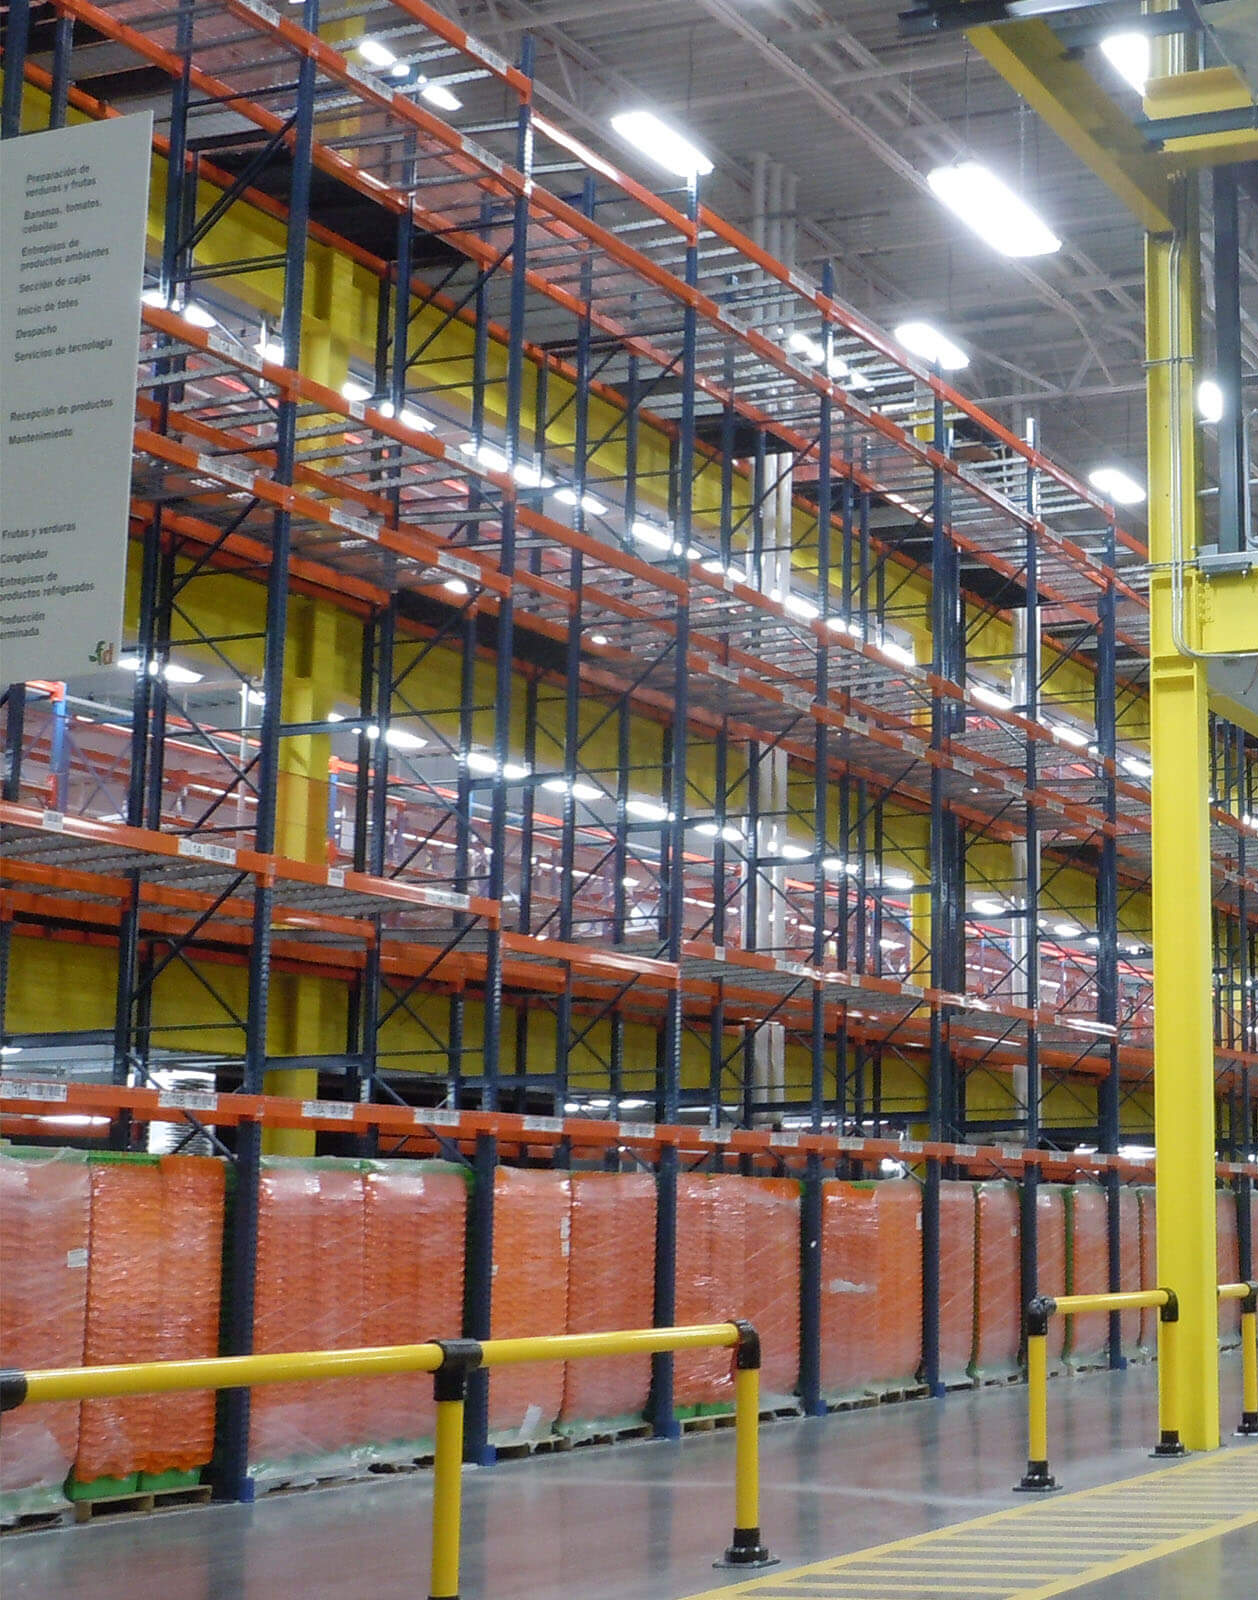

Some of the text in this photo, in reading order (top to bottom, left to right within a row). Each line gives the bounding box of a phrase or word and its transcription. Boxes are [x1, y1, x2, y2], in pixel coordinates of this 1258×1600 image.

[26, 164, 91, 184] Preparación de
[25, 177, 97, 198] verduras y frutas
[22, 220, 59, 234] cebollas
[21, 238, 80, 257] Entrepisos de
[19, 247, 109, 272] productos ambientes
[18, 273, 92, 294] Sección de cajas
[17, 298, 80, 316] Inicio de totes
[15, 325, 58, 340] Despacho
[14, 349, 53, 362] Servicios
[55, 345, 67, 356] de
[10, 398, 114, 422] Recepción de productos
[8, 428, 73, 445] Mantenimiento
[2, 522, 77, 539] Frutas y verduras
[0, 549, 49, 564] Congelador
[47, 571, 58, 581] de
[43, 582, 95, 597] refrigerados
